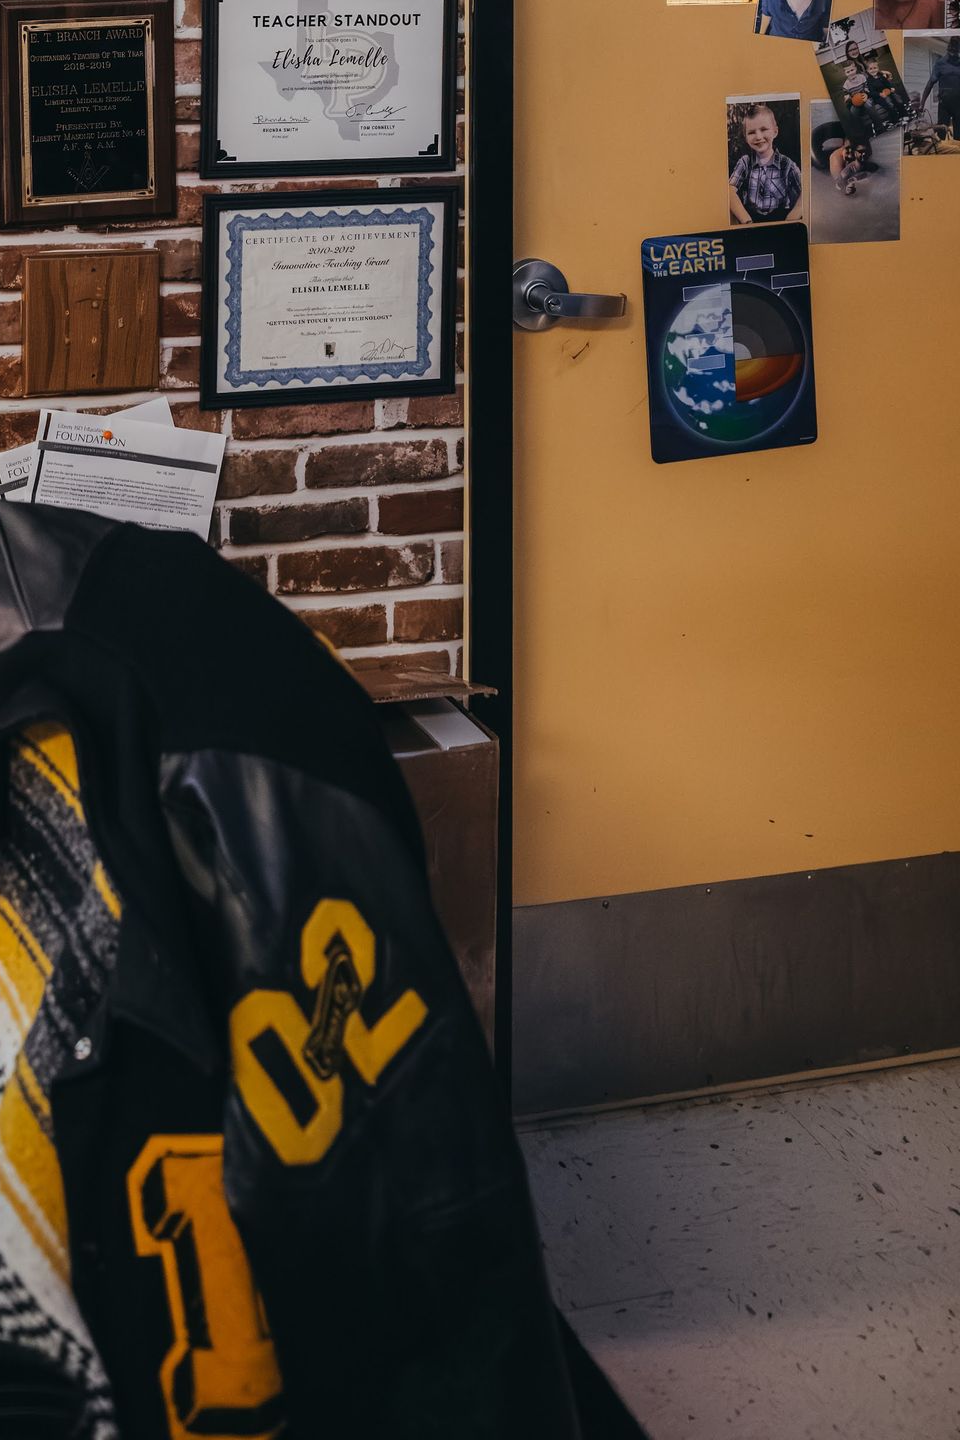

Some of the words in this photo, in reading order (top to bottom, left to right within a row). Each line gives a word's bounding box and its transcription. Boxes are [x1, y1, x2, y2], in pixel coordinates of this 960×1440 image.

[252, 14, 328, 28] TEACHER
[334, 13, 422, 26] STANDOUT
[272, 44, 323, 69] Elisha
[329, 47, 389, 67] Lemelle
[245, 236, 317, 245] CERTIFICATE
[340, 231, 417, 241] ACHIEVEMENT
[649, 238, 725, 262] LAYERS
[652, 262, 663, 270] OF
[653, 270, 668, 278] THE
[668, 256, 726, 276] EARTH
